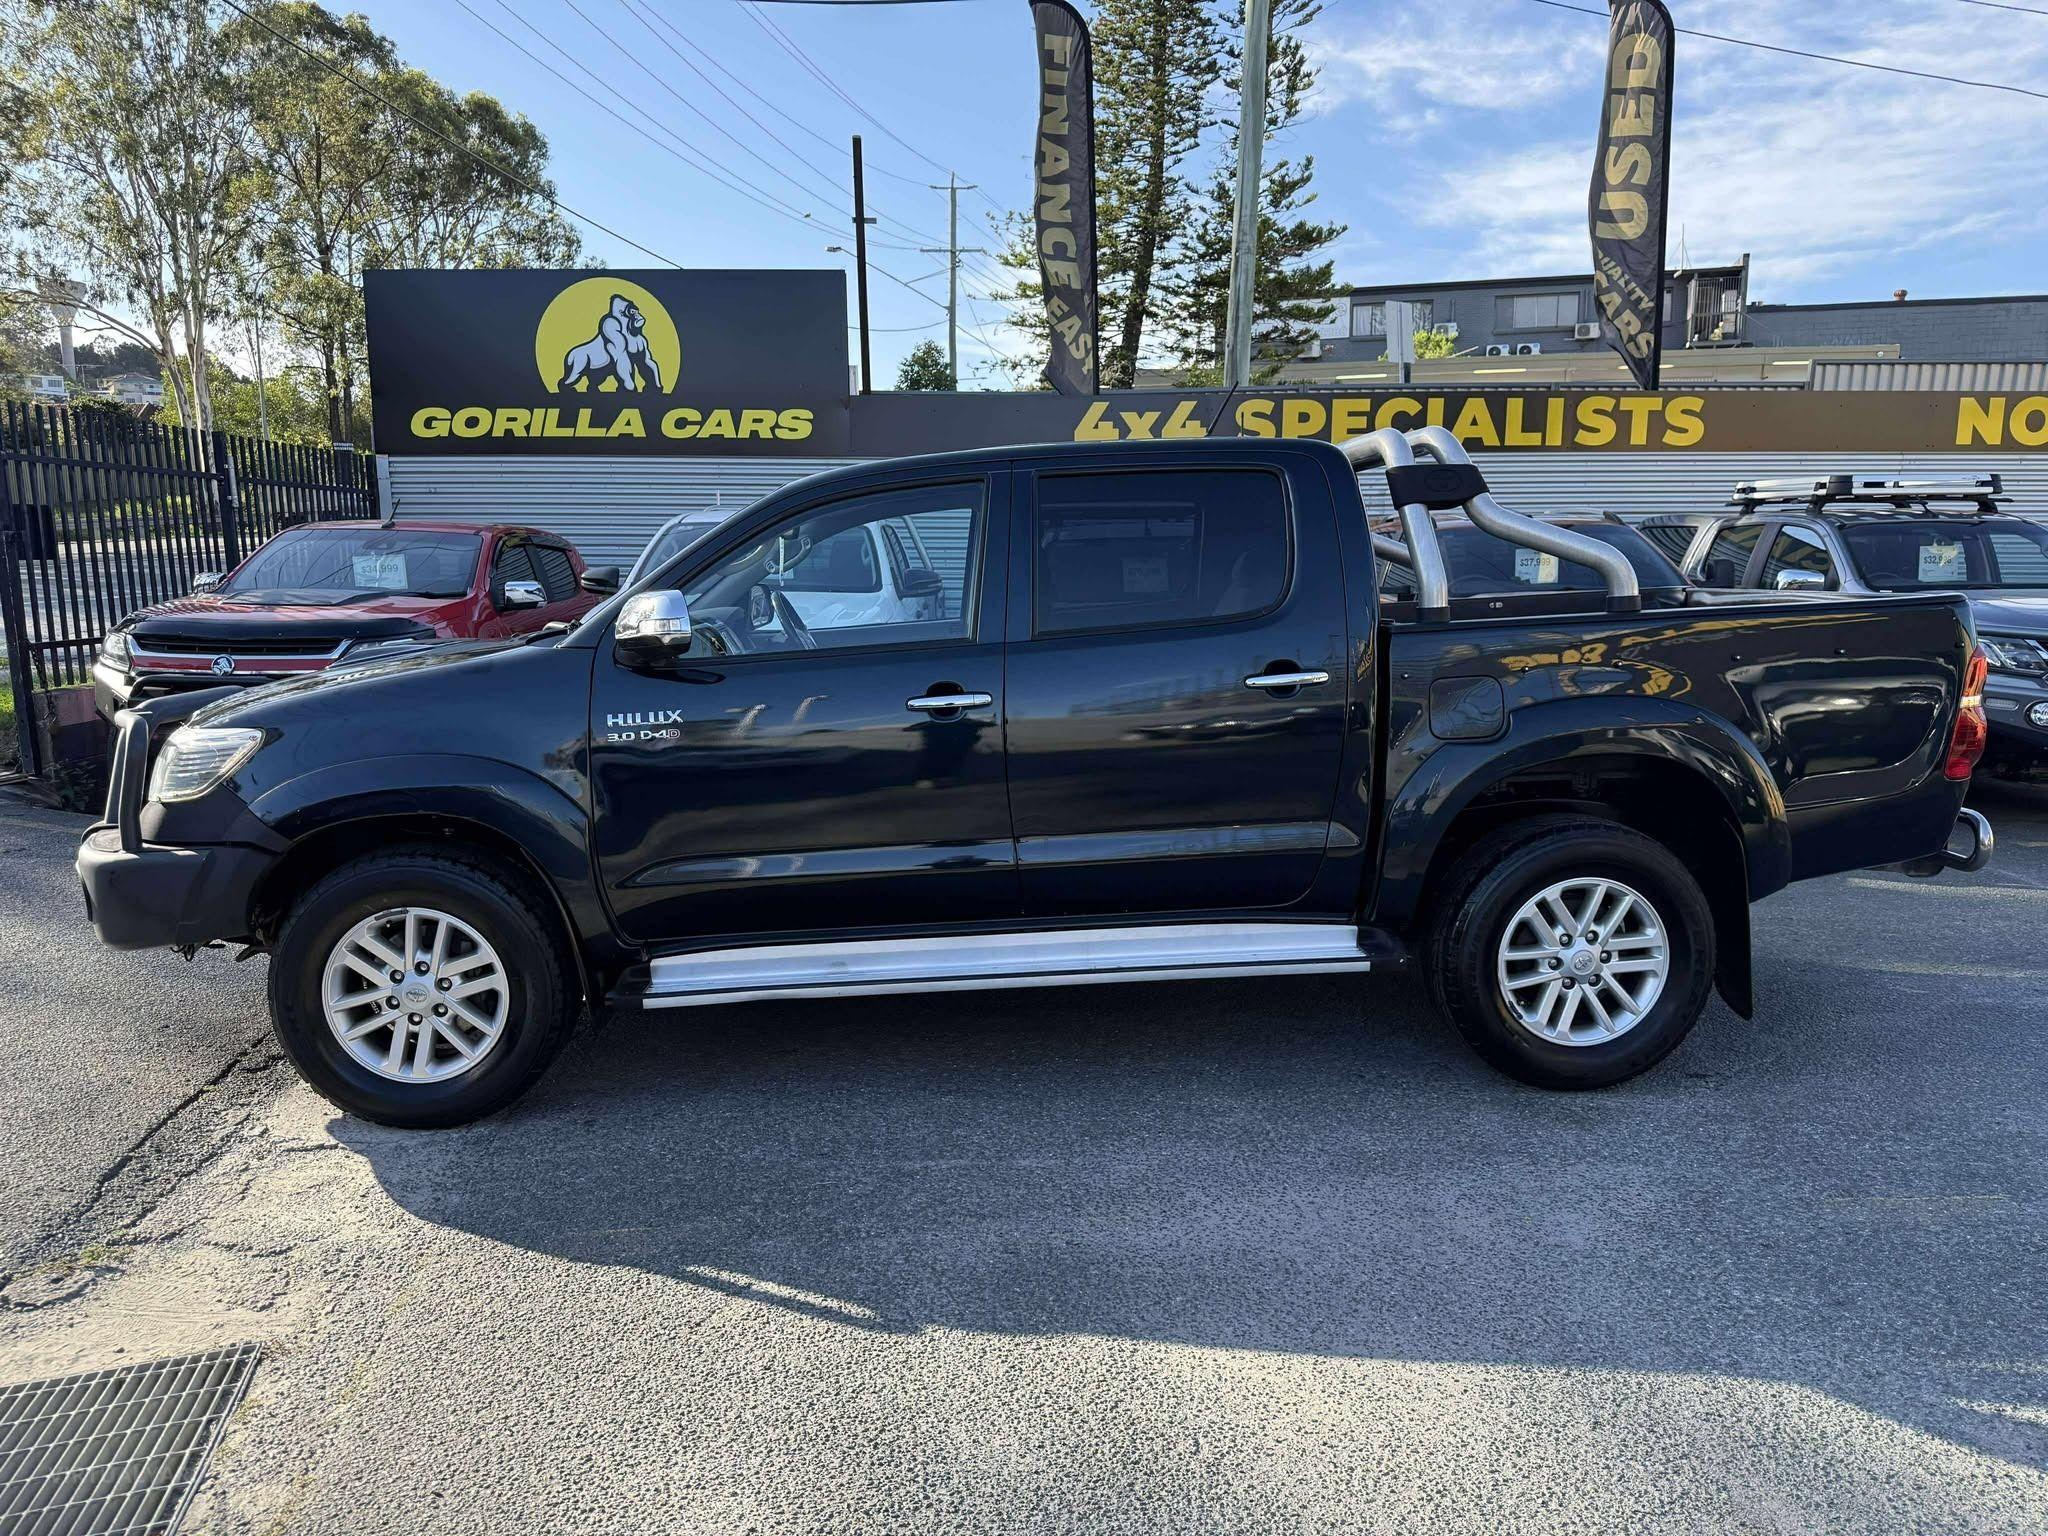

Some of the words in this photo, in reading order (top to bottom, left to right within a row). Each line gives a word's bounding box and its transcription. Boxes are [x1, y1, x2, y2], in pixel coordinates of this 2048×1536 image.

[1596, 32, 1662, 240] USED
[1039, 33, 1083, 290] FINANCE
[410, 407, 647, 438] GORILLA
[661, 408, 814, 440] CARS
[1073, 400, 1208, 441] 4x4
[1235, 395, 1705, 447] SPECIALISTS
[606, 709, 684, 727] HILUX
[640, 728, 681, 740] D-4D
